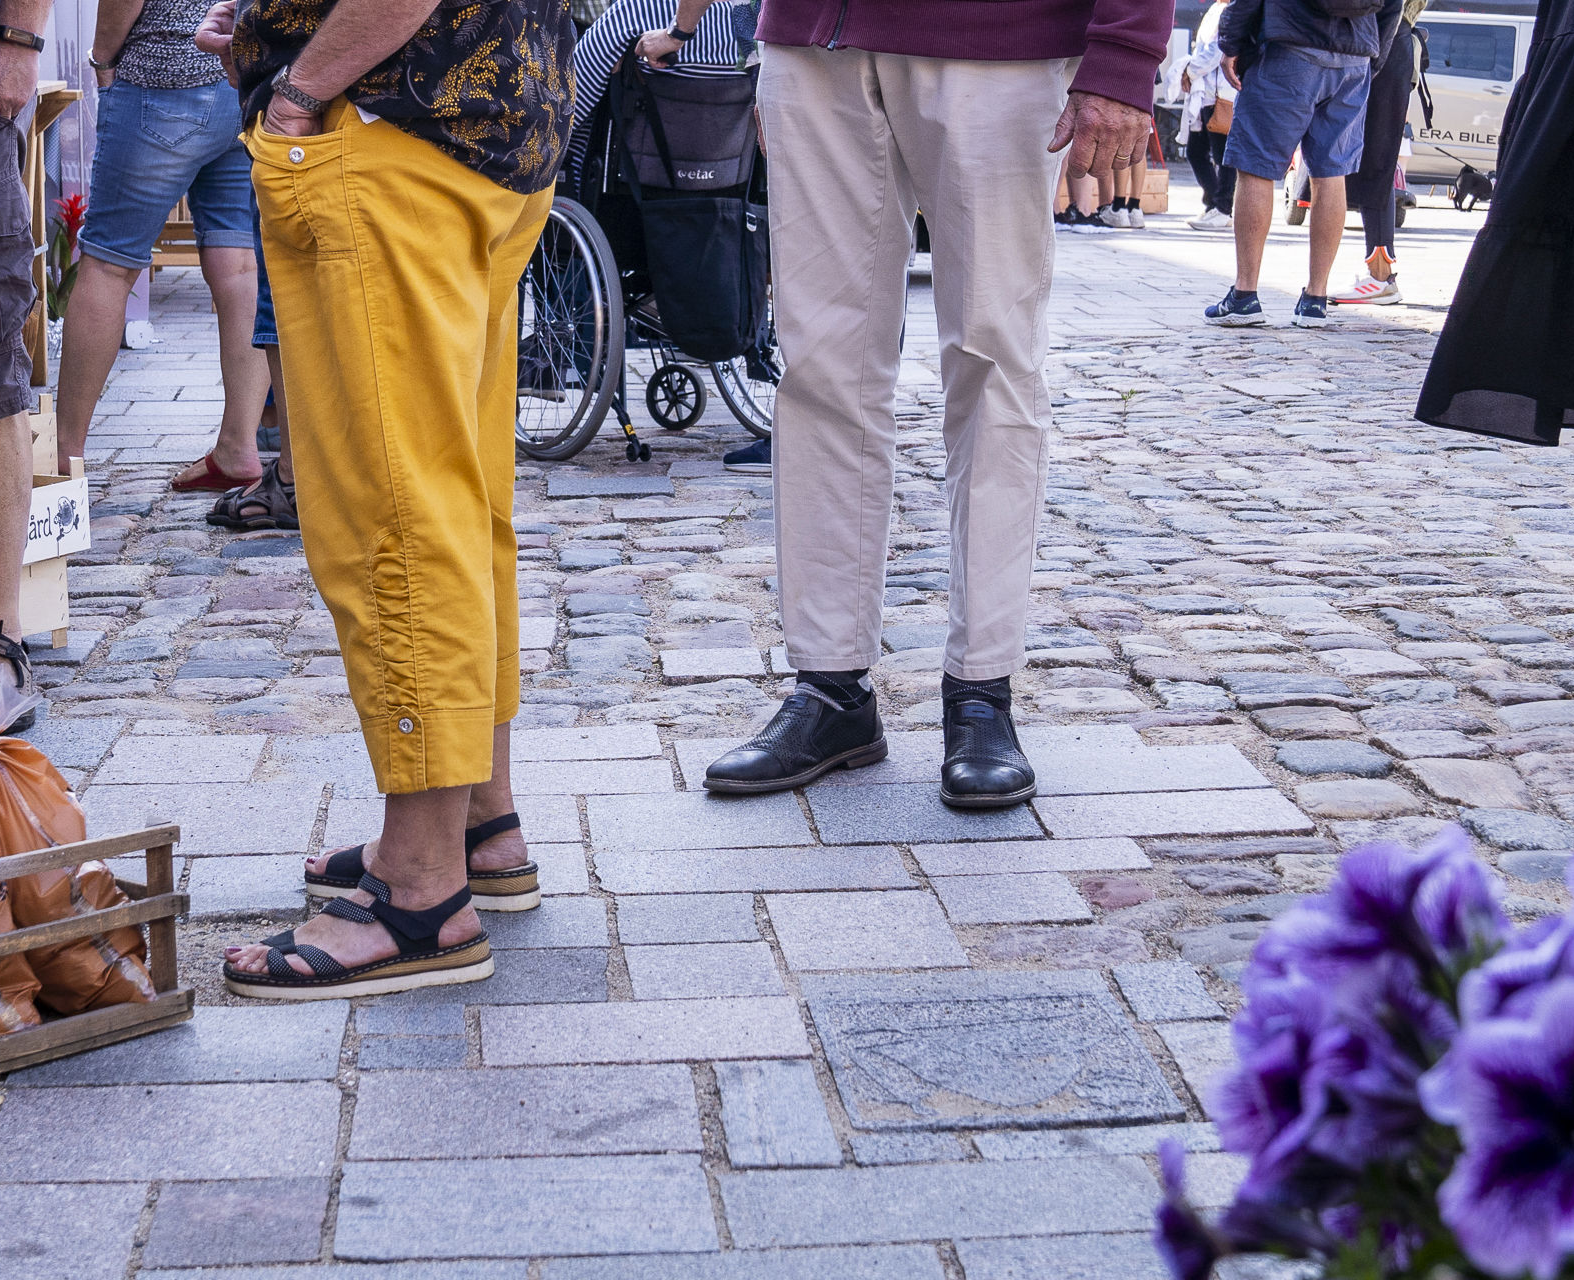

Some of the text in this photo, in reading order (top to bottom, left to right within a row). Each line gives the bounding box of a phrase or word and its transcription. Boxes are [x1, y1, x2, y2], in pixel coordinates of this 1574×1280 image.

[1459, 132, 1501, 145] BILE
[687, 169, 715, 180] etac
[25, 506, 53, 548] ård
